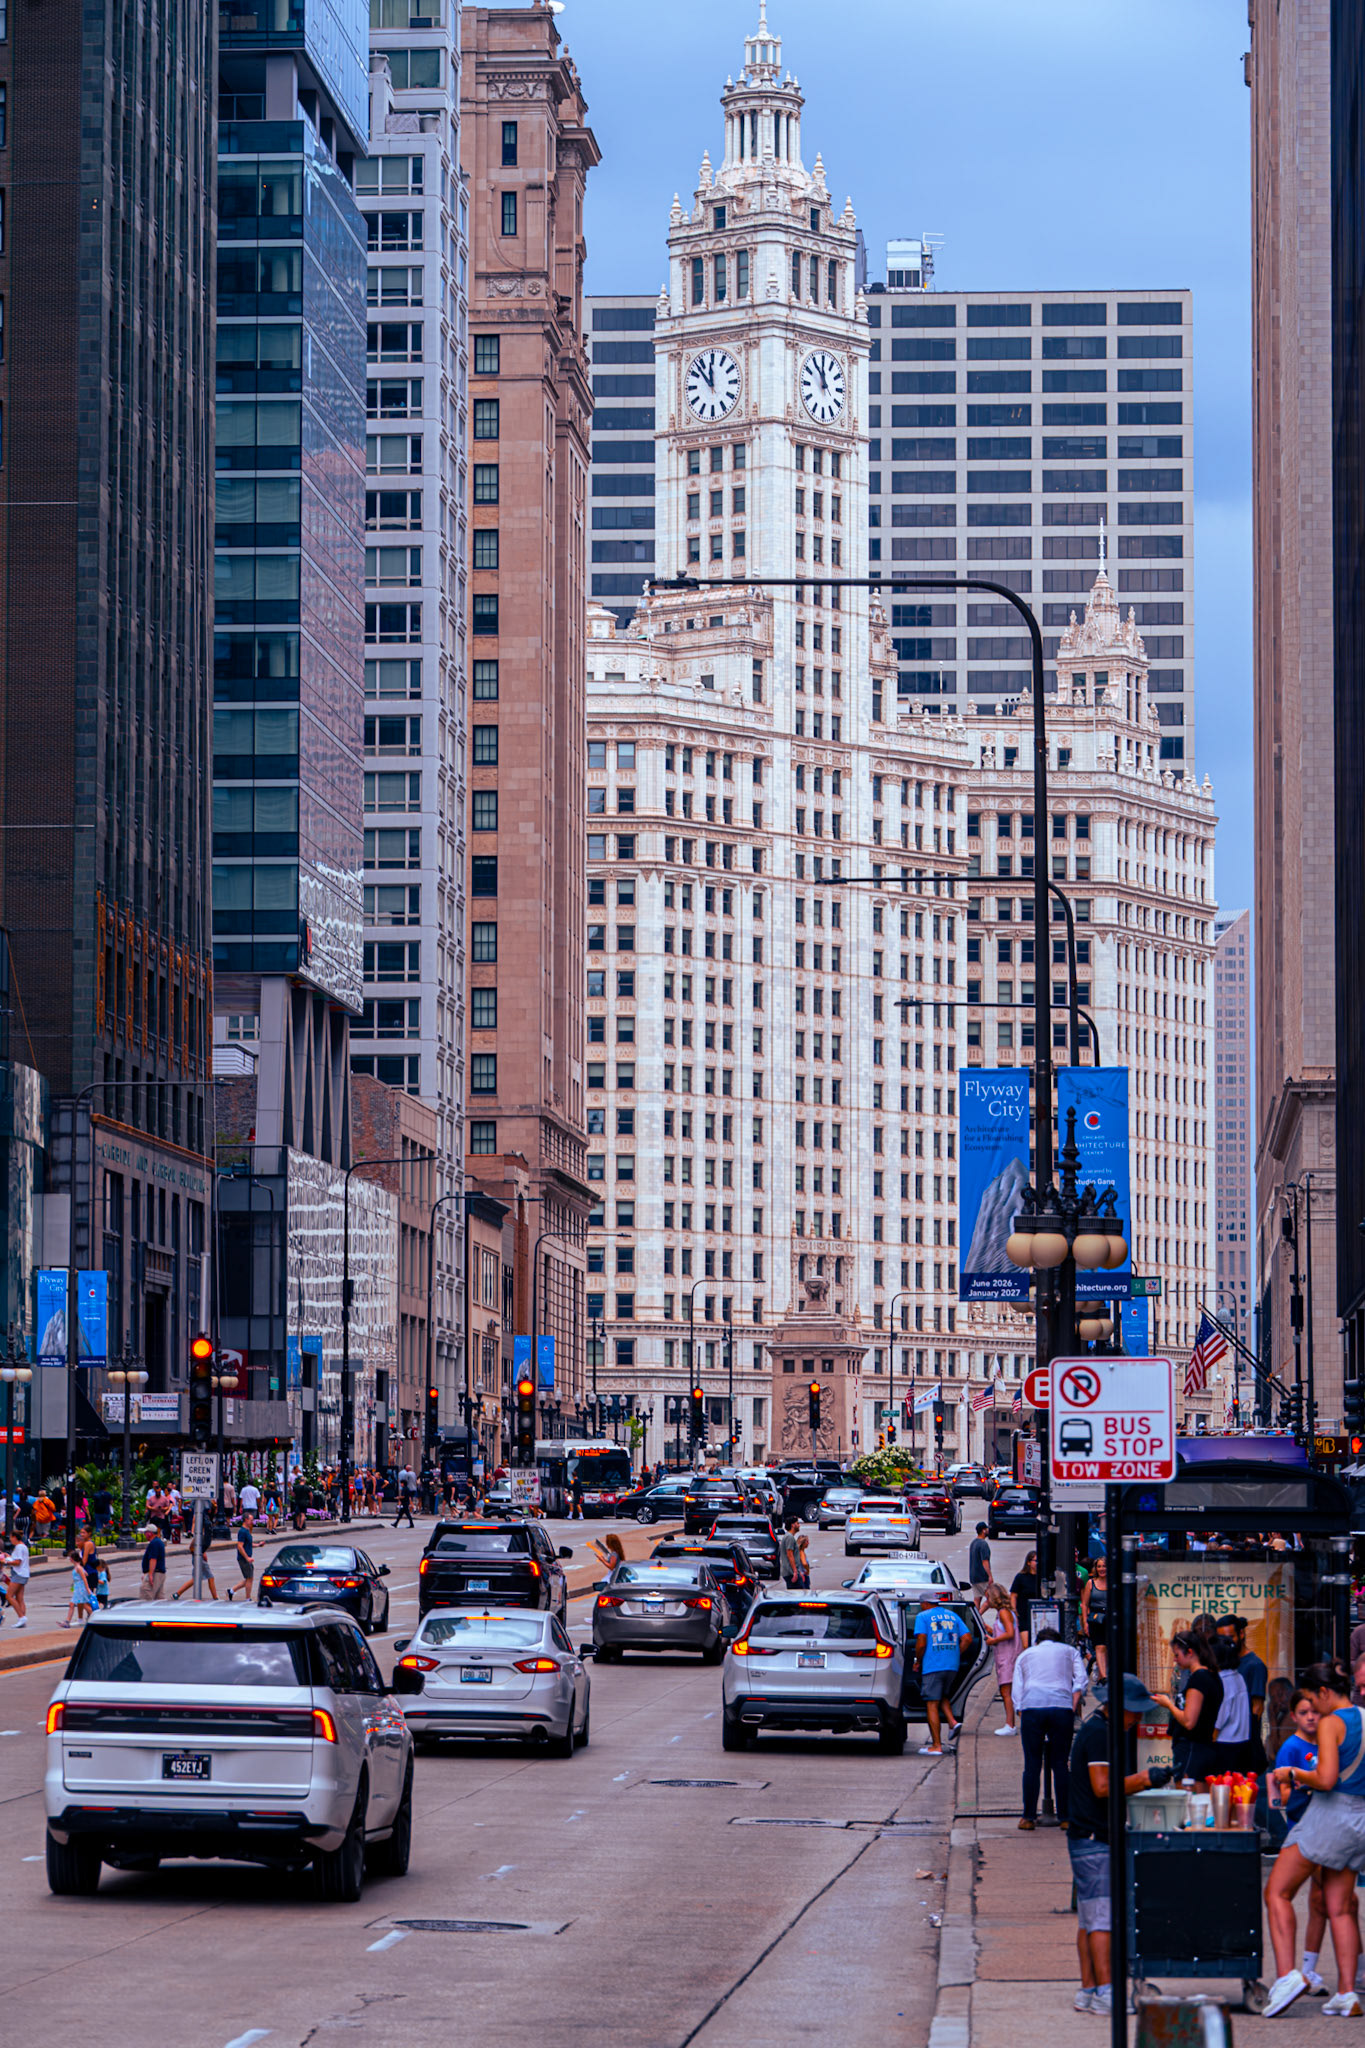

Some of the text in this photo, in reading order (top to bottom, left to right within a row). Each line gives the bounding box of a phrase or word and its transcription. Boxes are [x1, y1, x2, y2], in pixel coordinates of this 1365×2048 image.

[964, 1080, 1024, 1102] Flyway
[988, 1100, 1024, 1122] City
[982, 1134, 1024, 1143] Flourishing
[136, 1154, 148, 1174] AND
[152, 1160, 176, 1184] CARBON
[40, 1276, 64, 1285] Flyway
[49, 1285, 64, 1294] City
[1104, 1417, 1150, 1435] BUS
[1104, 1438, 1163, 1456] STOP
[1060, 1462, 1162, 1477] TOW ZONE
[1145, 1583, 1286, 1598] ARCHITECTURE
[1191, 1600, 1240, 1614] FIRST
[115, 1710, 260, 1720] LINCOLN
[171, 1761, 202, 1774] 452EYJ
